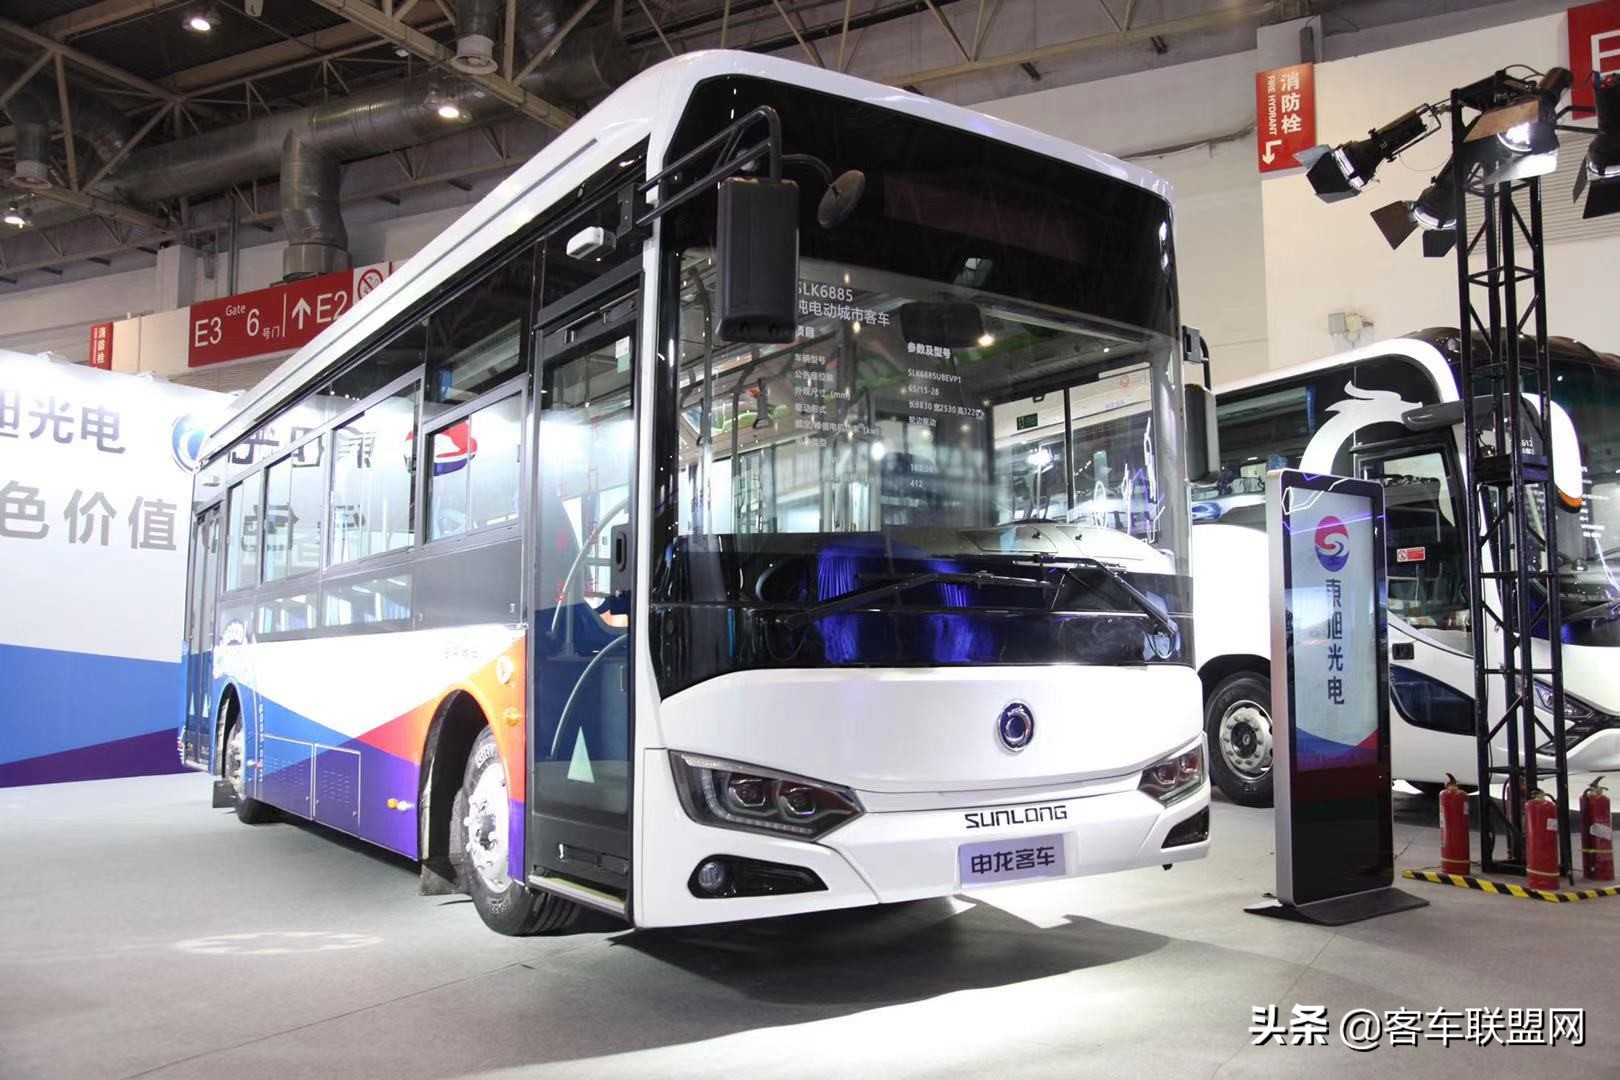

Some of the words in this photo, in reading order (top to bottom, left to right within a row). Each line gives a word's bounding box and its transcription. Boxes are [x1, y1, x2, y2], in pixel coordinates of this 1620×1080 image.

[1267, 75, 1276, 94] FIRE
[1268, 94, 1278, 136] HYDRANT
[1281, 71, 1302, 134] 消防栓
[194, 316, 223, 347] E3
[225, 304, 246, 317] Gate
[246, 308, 260, 337] 6
[262, 325, 280, 340] 号门
[316, 290, 348, 324] E2
[907, 341, 951, 359] 参数及型号
[0, 480, 177, 551] 色价值
[964, 805, 1067, 829] SUNLONG
[971, 846, 1056, 875] 申龙客车
